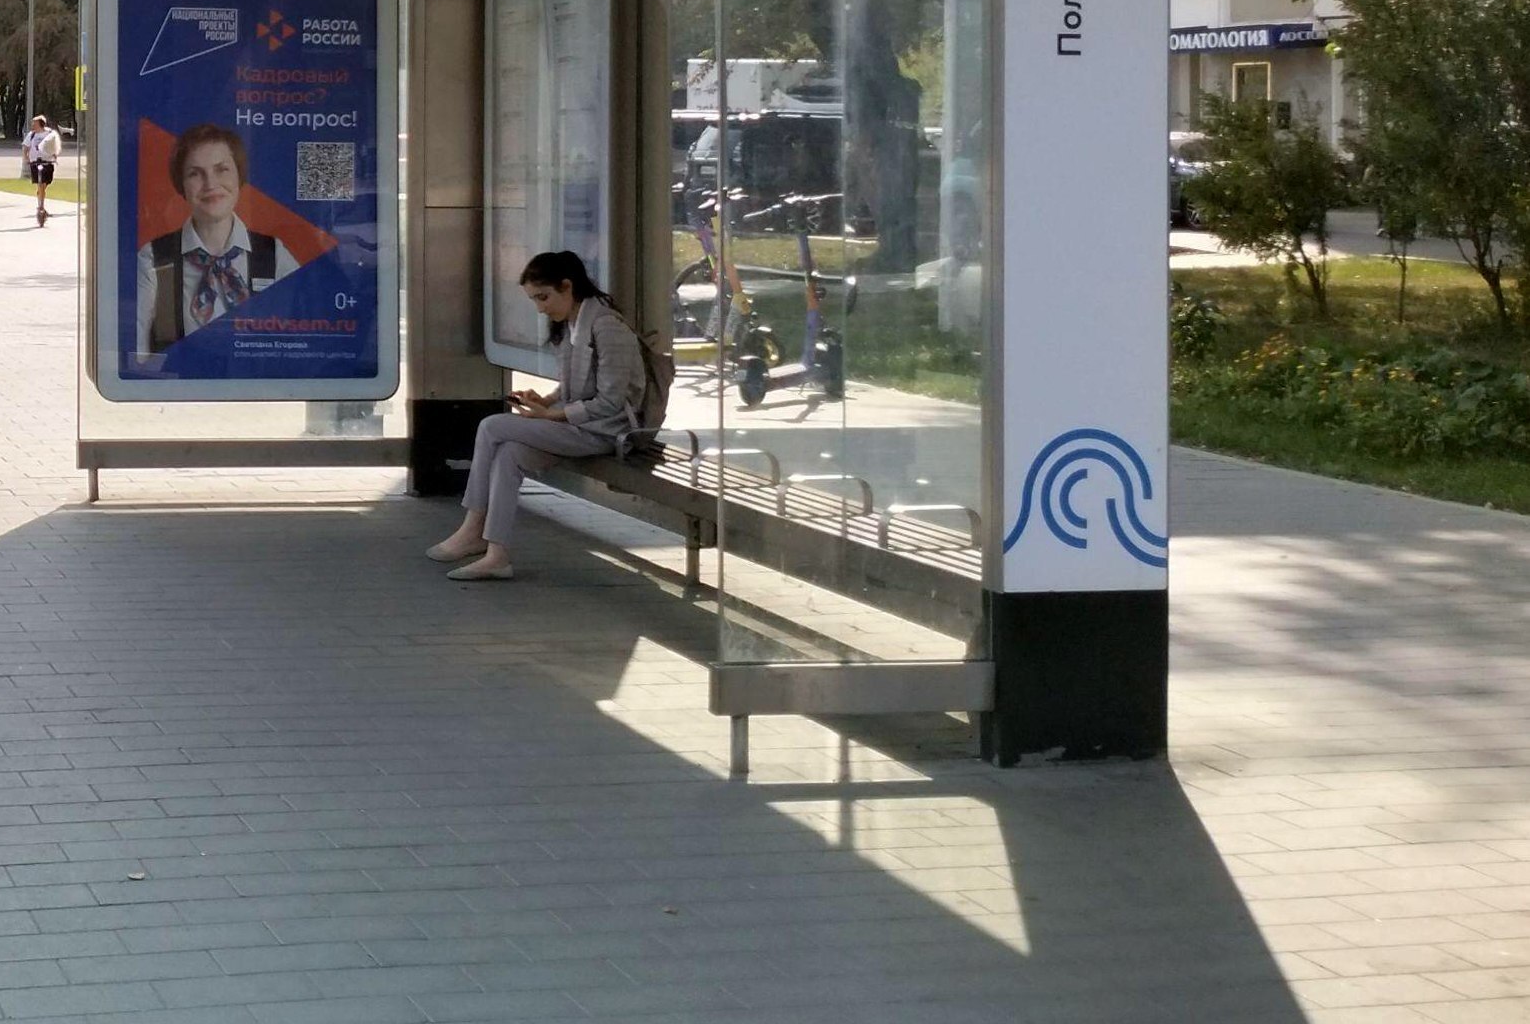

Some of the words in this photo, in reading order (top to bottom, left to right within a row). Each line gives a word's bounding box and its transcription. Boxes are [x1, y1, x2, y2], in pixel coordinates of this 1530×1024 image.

[172, 10, 236, 20] НАЦИОНАЛЬНЫЕ
[199, 21, 236, 30] ПРОЕКТЫ
[302, 19, 358, 31] РАБОТА
[206, 31, 236, 41] РОССИИ
[302, 33, 361, 45] РОССИИ
[1170, 29, 1269, 51] ОМАТОЛОГИЯ
[236, 65, 348, 84] Кадровый
[236, 88, 327, 107] вопрос?
[236, 109, 265, 125] Не
[272, 110, 357, 130] вопрос!
[335, 293, 358, 311] 0+
[234, 316, 356, 332] trudvsem.ru
